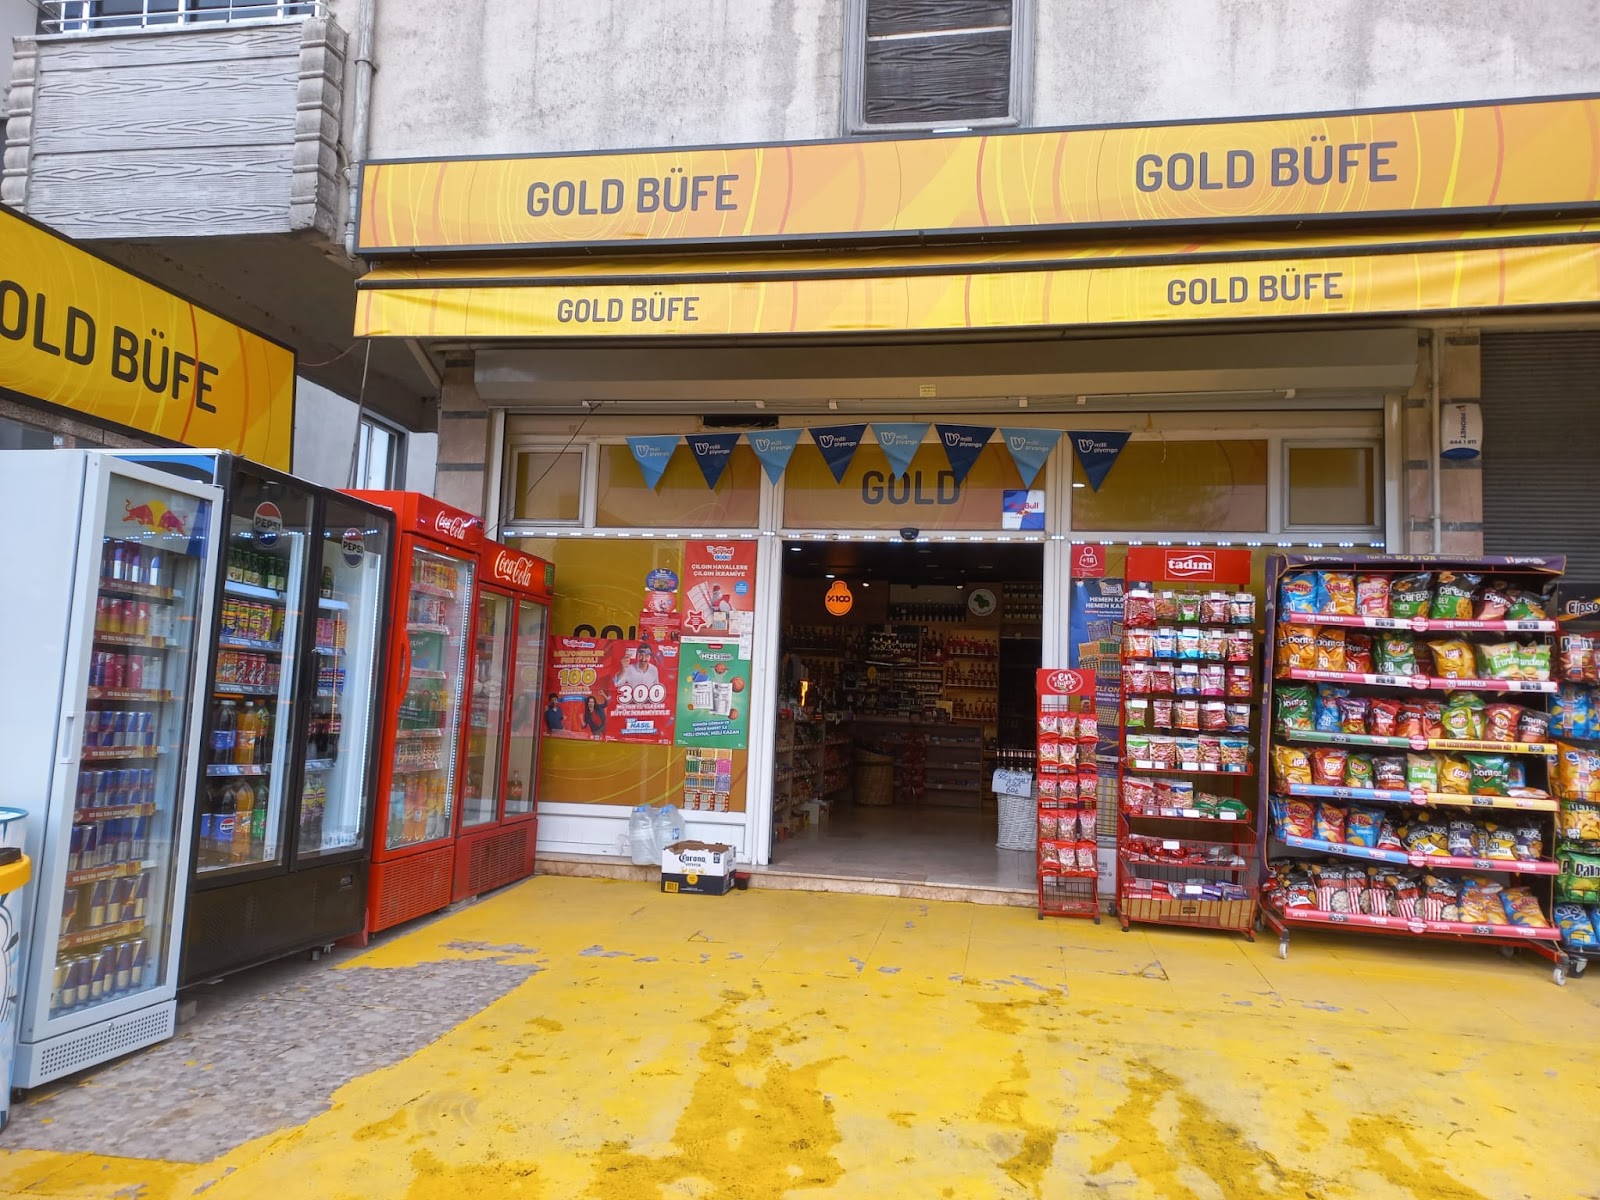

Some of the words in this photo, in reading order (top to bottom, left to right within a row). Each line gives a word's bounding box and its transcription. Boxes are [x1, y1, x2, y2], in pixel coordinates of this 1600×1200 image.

[1136, 149, 1254, 192] GOLD
[1271, 135, 1398, 188] BÜFE
[526, 179, 624, 218] GOLD
[636, 167, 739, 212] BÜFE
[1167, 276, 1249, 306] GOLD
[1259, 268, 1343, 301] BÜFE
[557, 297, 624, 324] GOLD
[631, 292, 699, 322] BÜFE
[112, 328, 219, 414] BÜFE
[862, 470, 960, 505] GOLD
[255, 516, 281, 531] PEPSI
[343, 541, 363, 553] PEPSI
[1168, 559, 1213, 571] tadım
[558, 668, 597, 686] 100
[618, 683, 665, 703] 300
[679, 854, 706, 863] Corona
